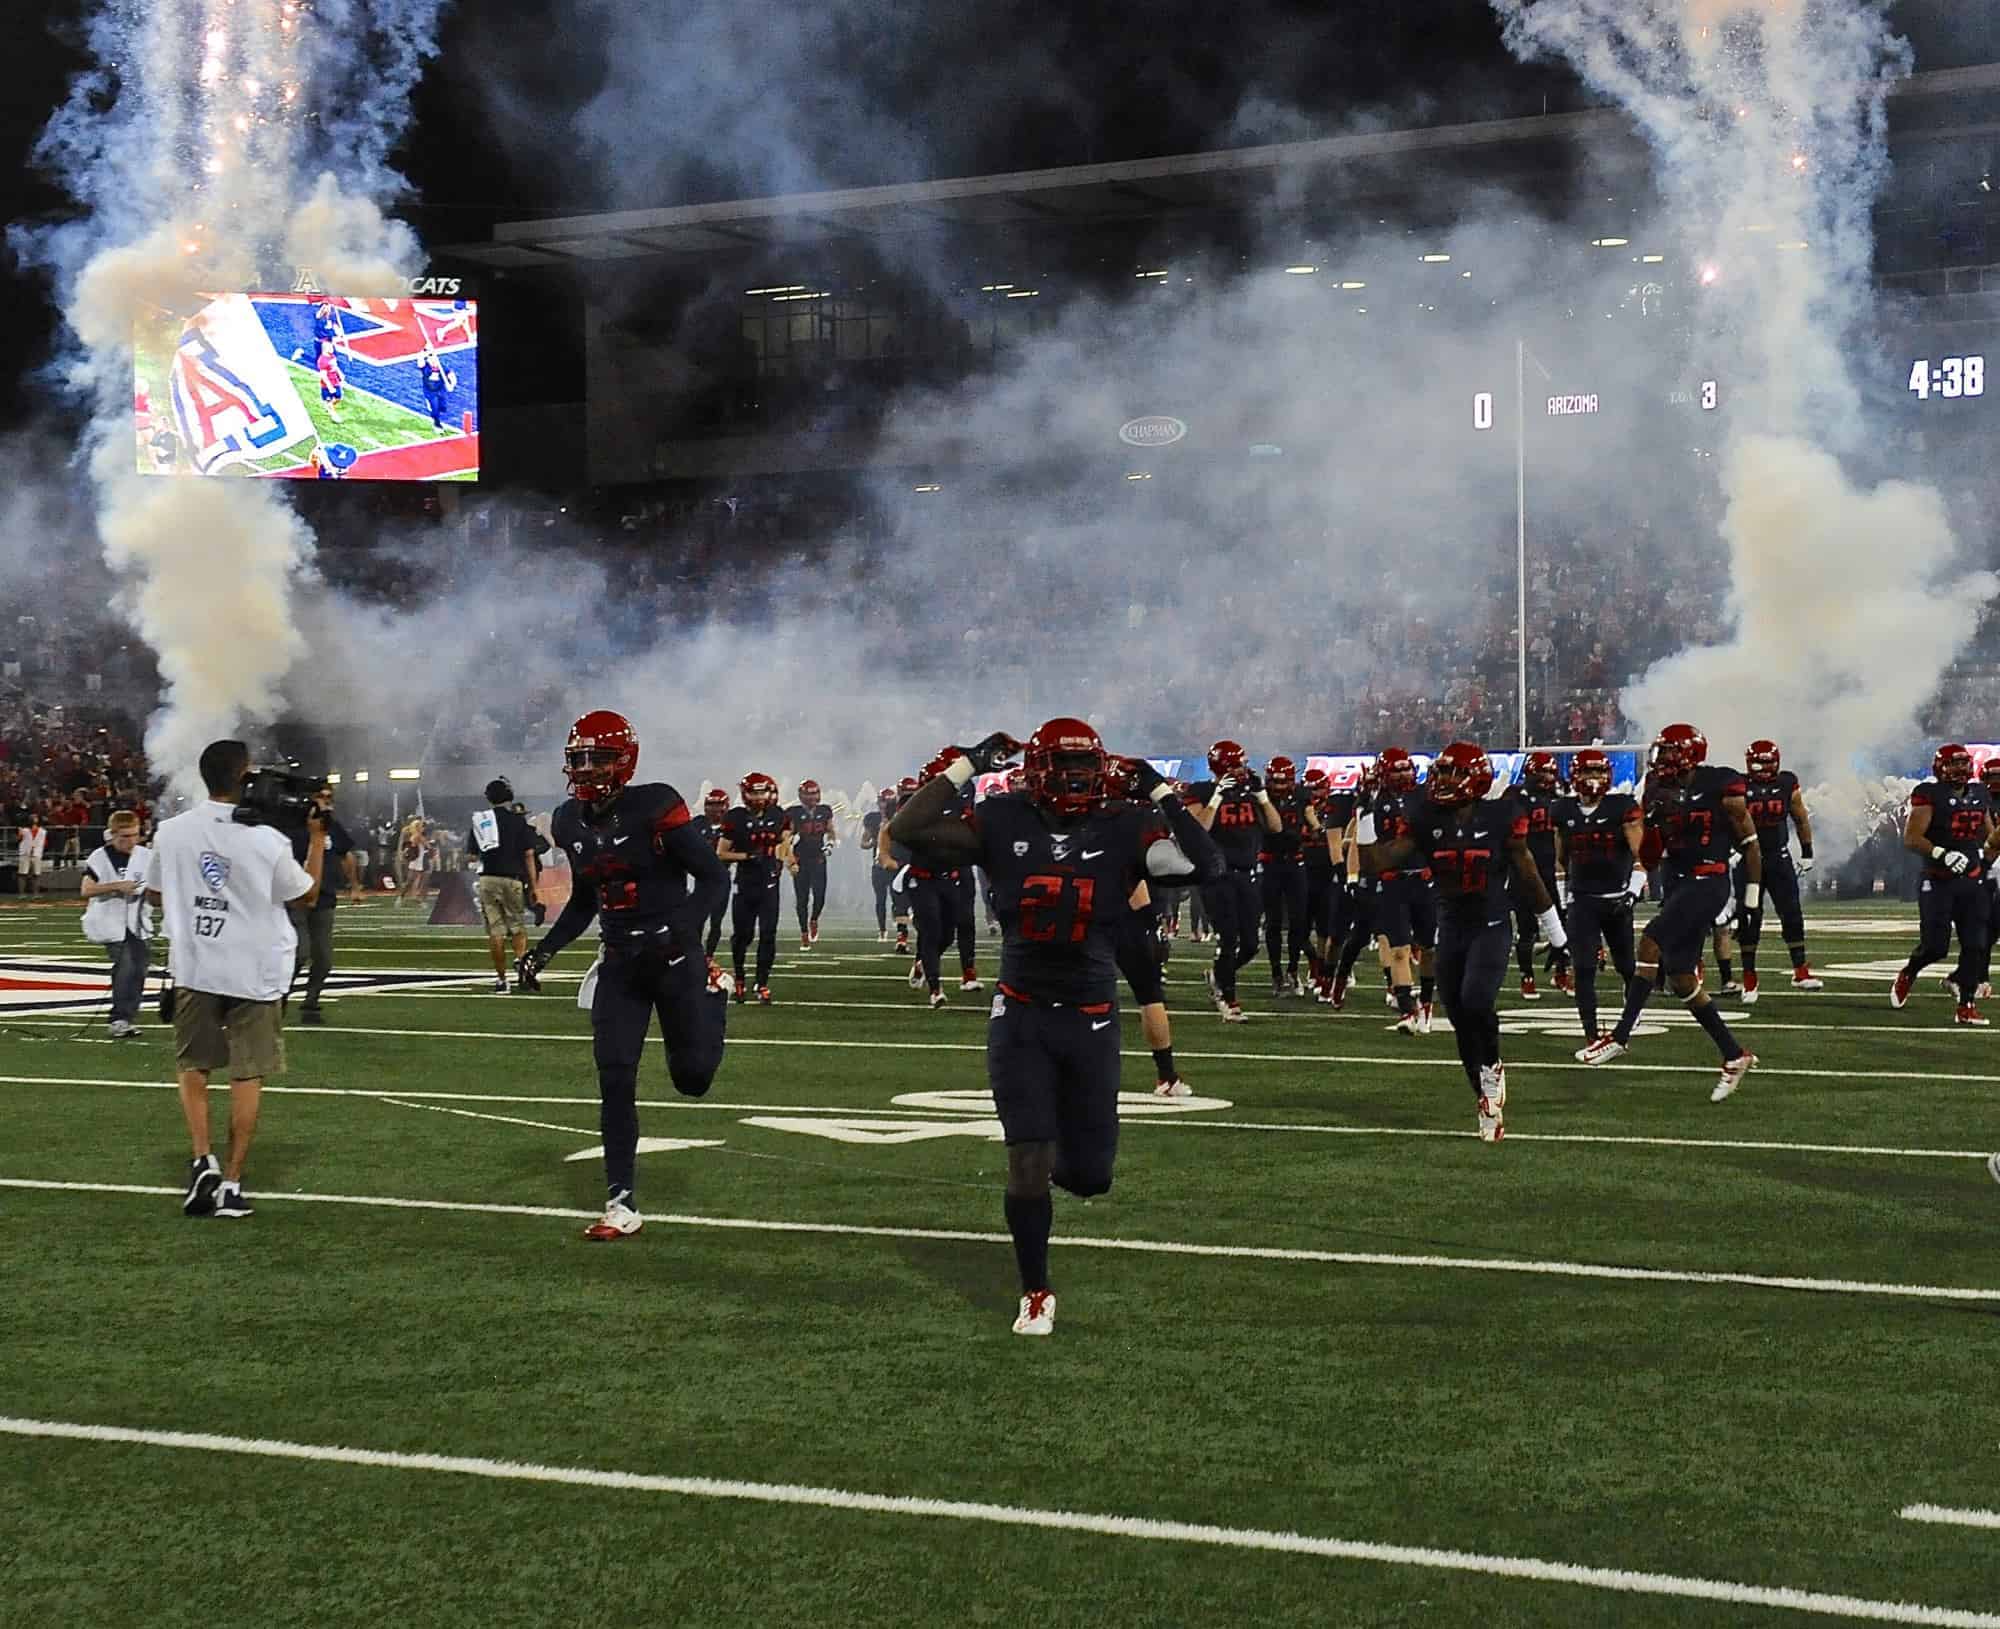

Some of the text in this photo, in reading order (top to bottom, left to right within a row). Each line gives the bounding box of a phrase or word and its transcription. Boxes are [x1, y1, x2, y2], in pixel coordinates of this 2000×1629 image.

[1909, 356, 1984, 400] 4:38
[1547, 394, 1598, 415] ARIZONA
[1702, 381, 1717, 409] 3
[1474, 392, 1492, 429] 0
[194, 895, 229, 912] MEDIA
[1020, 875, 1095, 943] 21
[195, 914, 226, 938] 137
